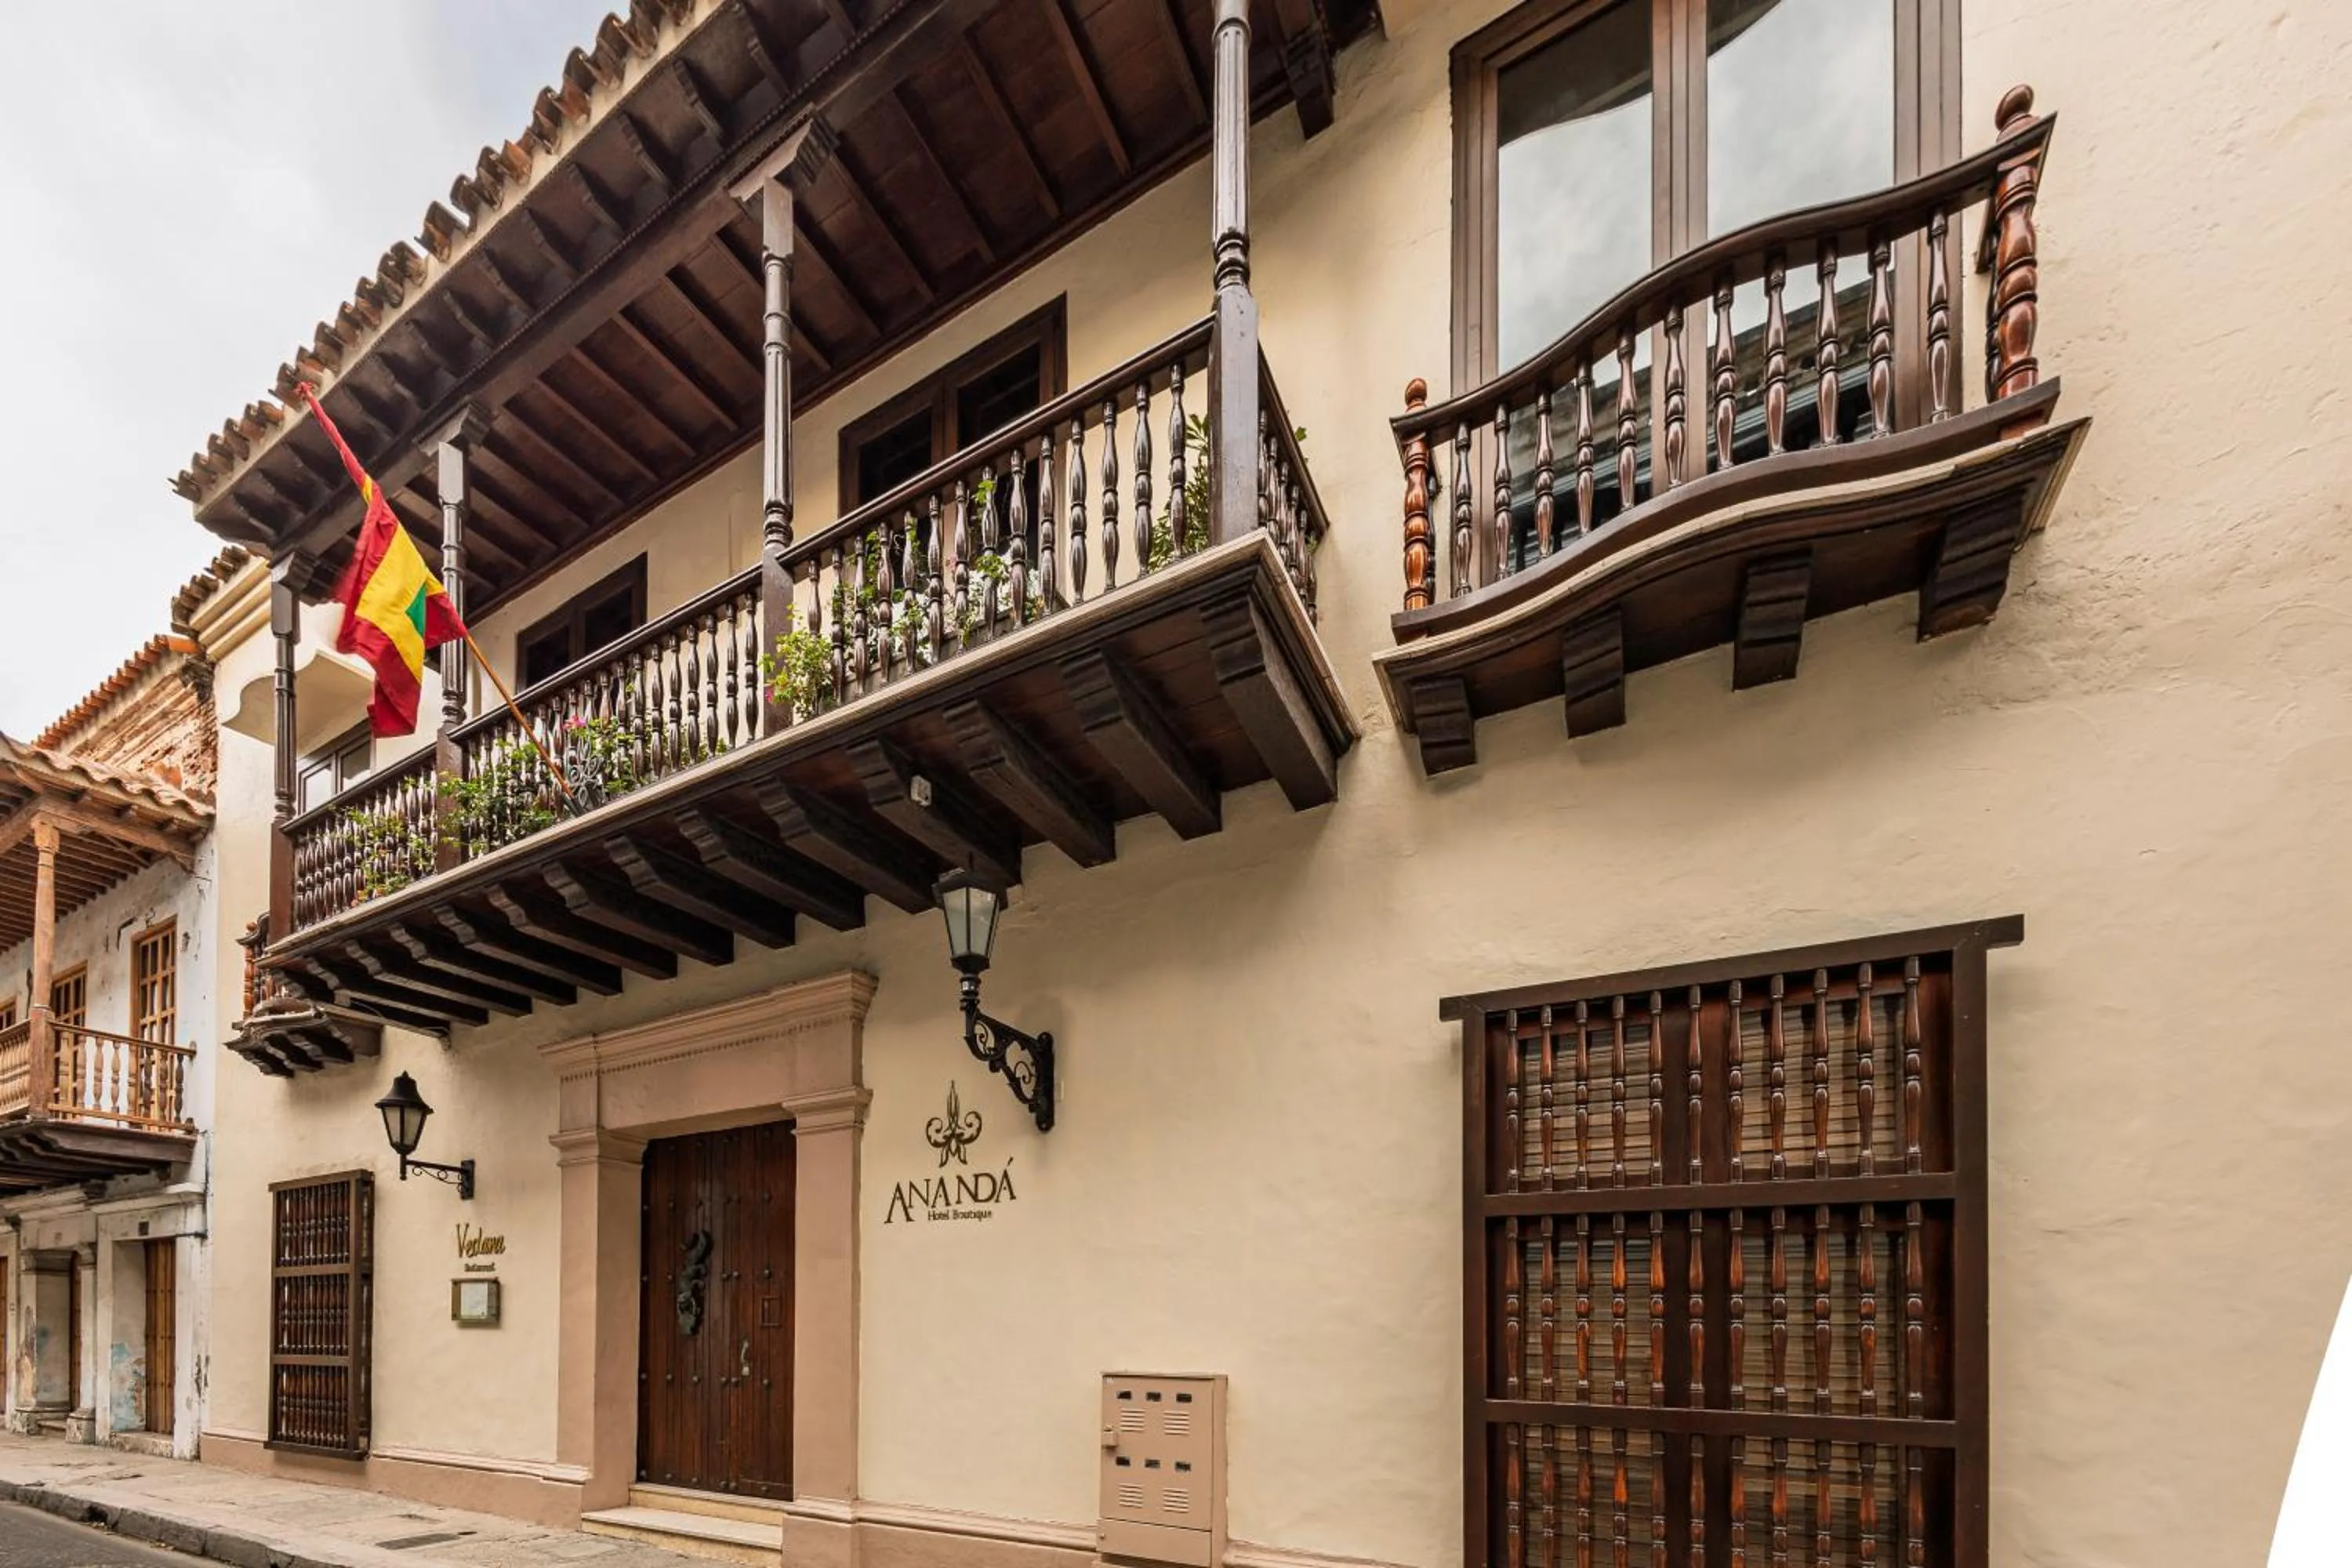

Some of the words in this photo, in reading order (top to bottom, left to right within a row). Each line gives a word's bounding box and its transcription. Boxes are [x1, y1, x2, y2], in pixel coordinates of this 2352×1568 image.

[884, 1156, 1017, 1225] ANANDÁ
[927, 1210, 949, 1221] Hotel
[952, 1209, 992, 1222] Boutique
